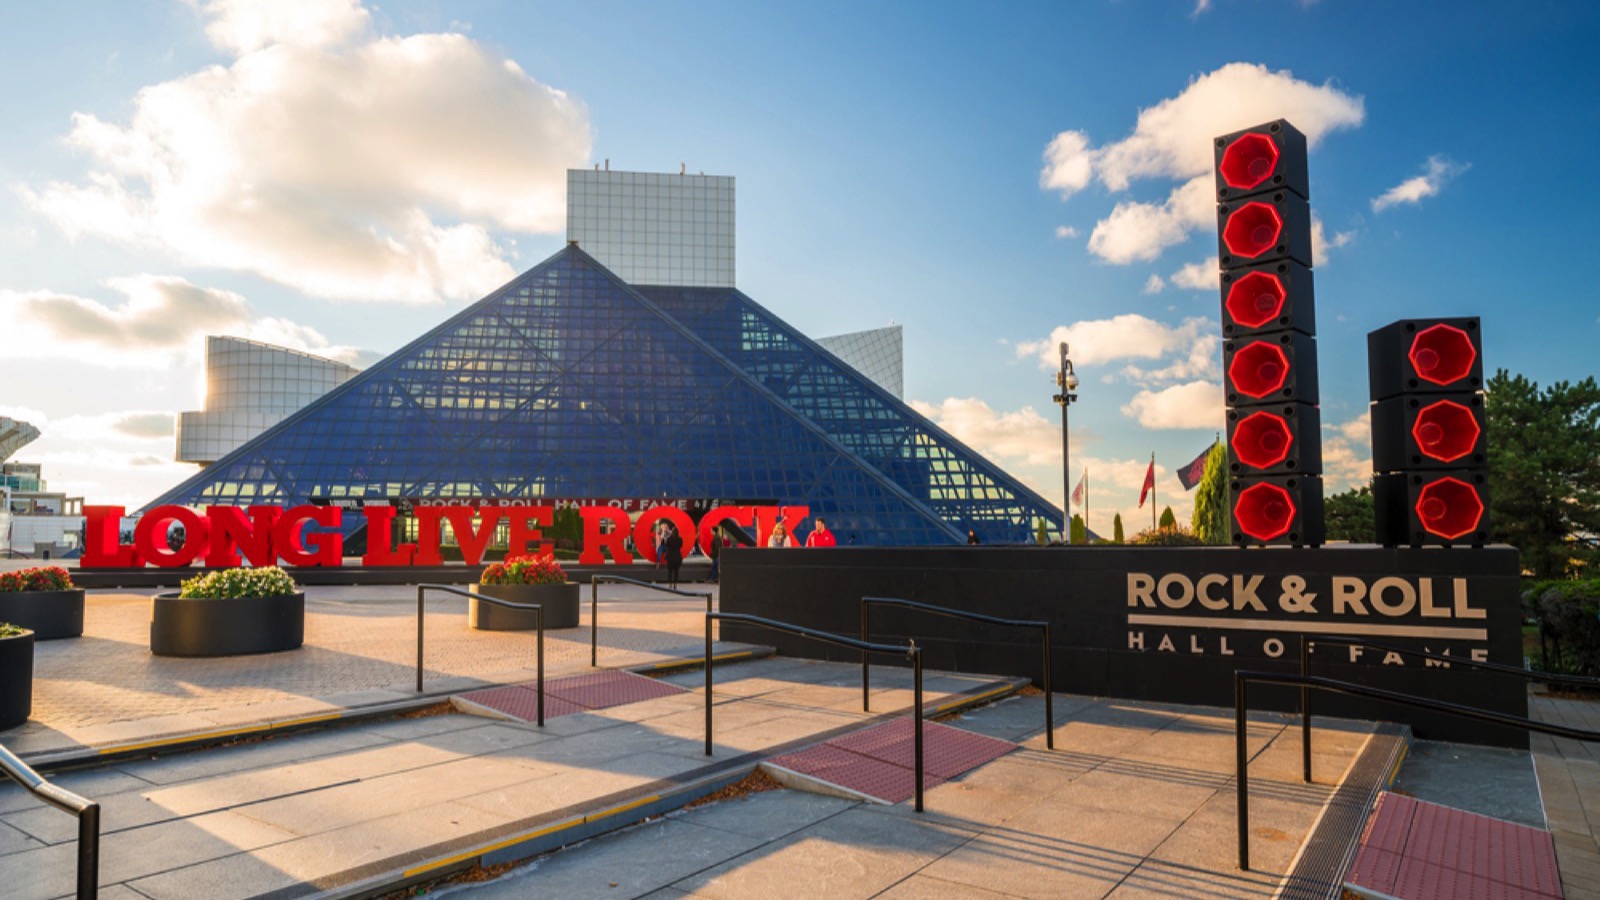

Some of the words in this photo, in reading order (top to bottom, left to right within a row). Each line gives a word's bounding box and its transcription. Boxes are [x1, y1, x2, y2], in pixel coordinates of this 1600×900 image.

[607, 499, 633, 510] OF
[80, 505, 343, 567] LONG
[363, 505, 554, 566] LIVE
[579, 505, 809, 566] ROCK
[1127, 572, 1268, 612] ROCK
[1278, 575, 1318, 614] &
[1332, 576, 1487, 619] ROLL
[1127, 631, 1235, 656] HALL
